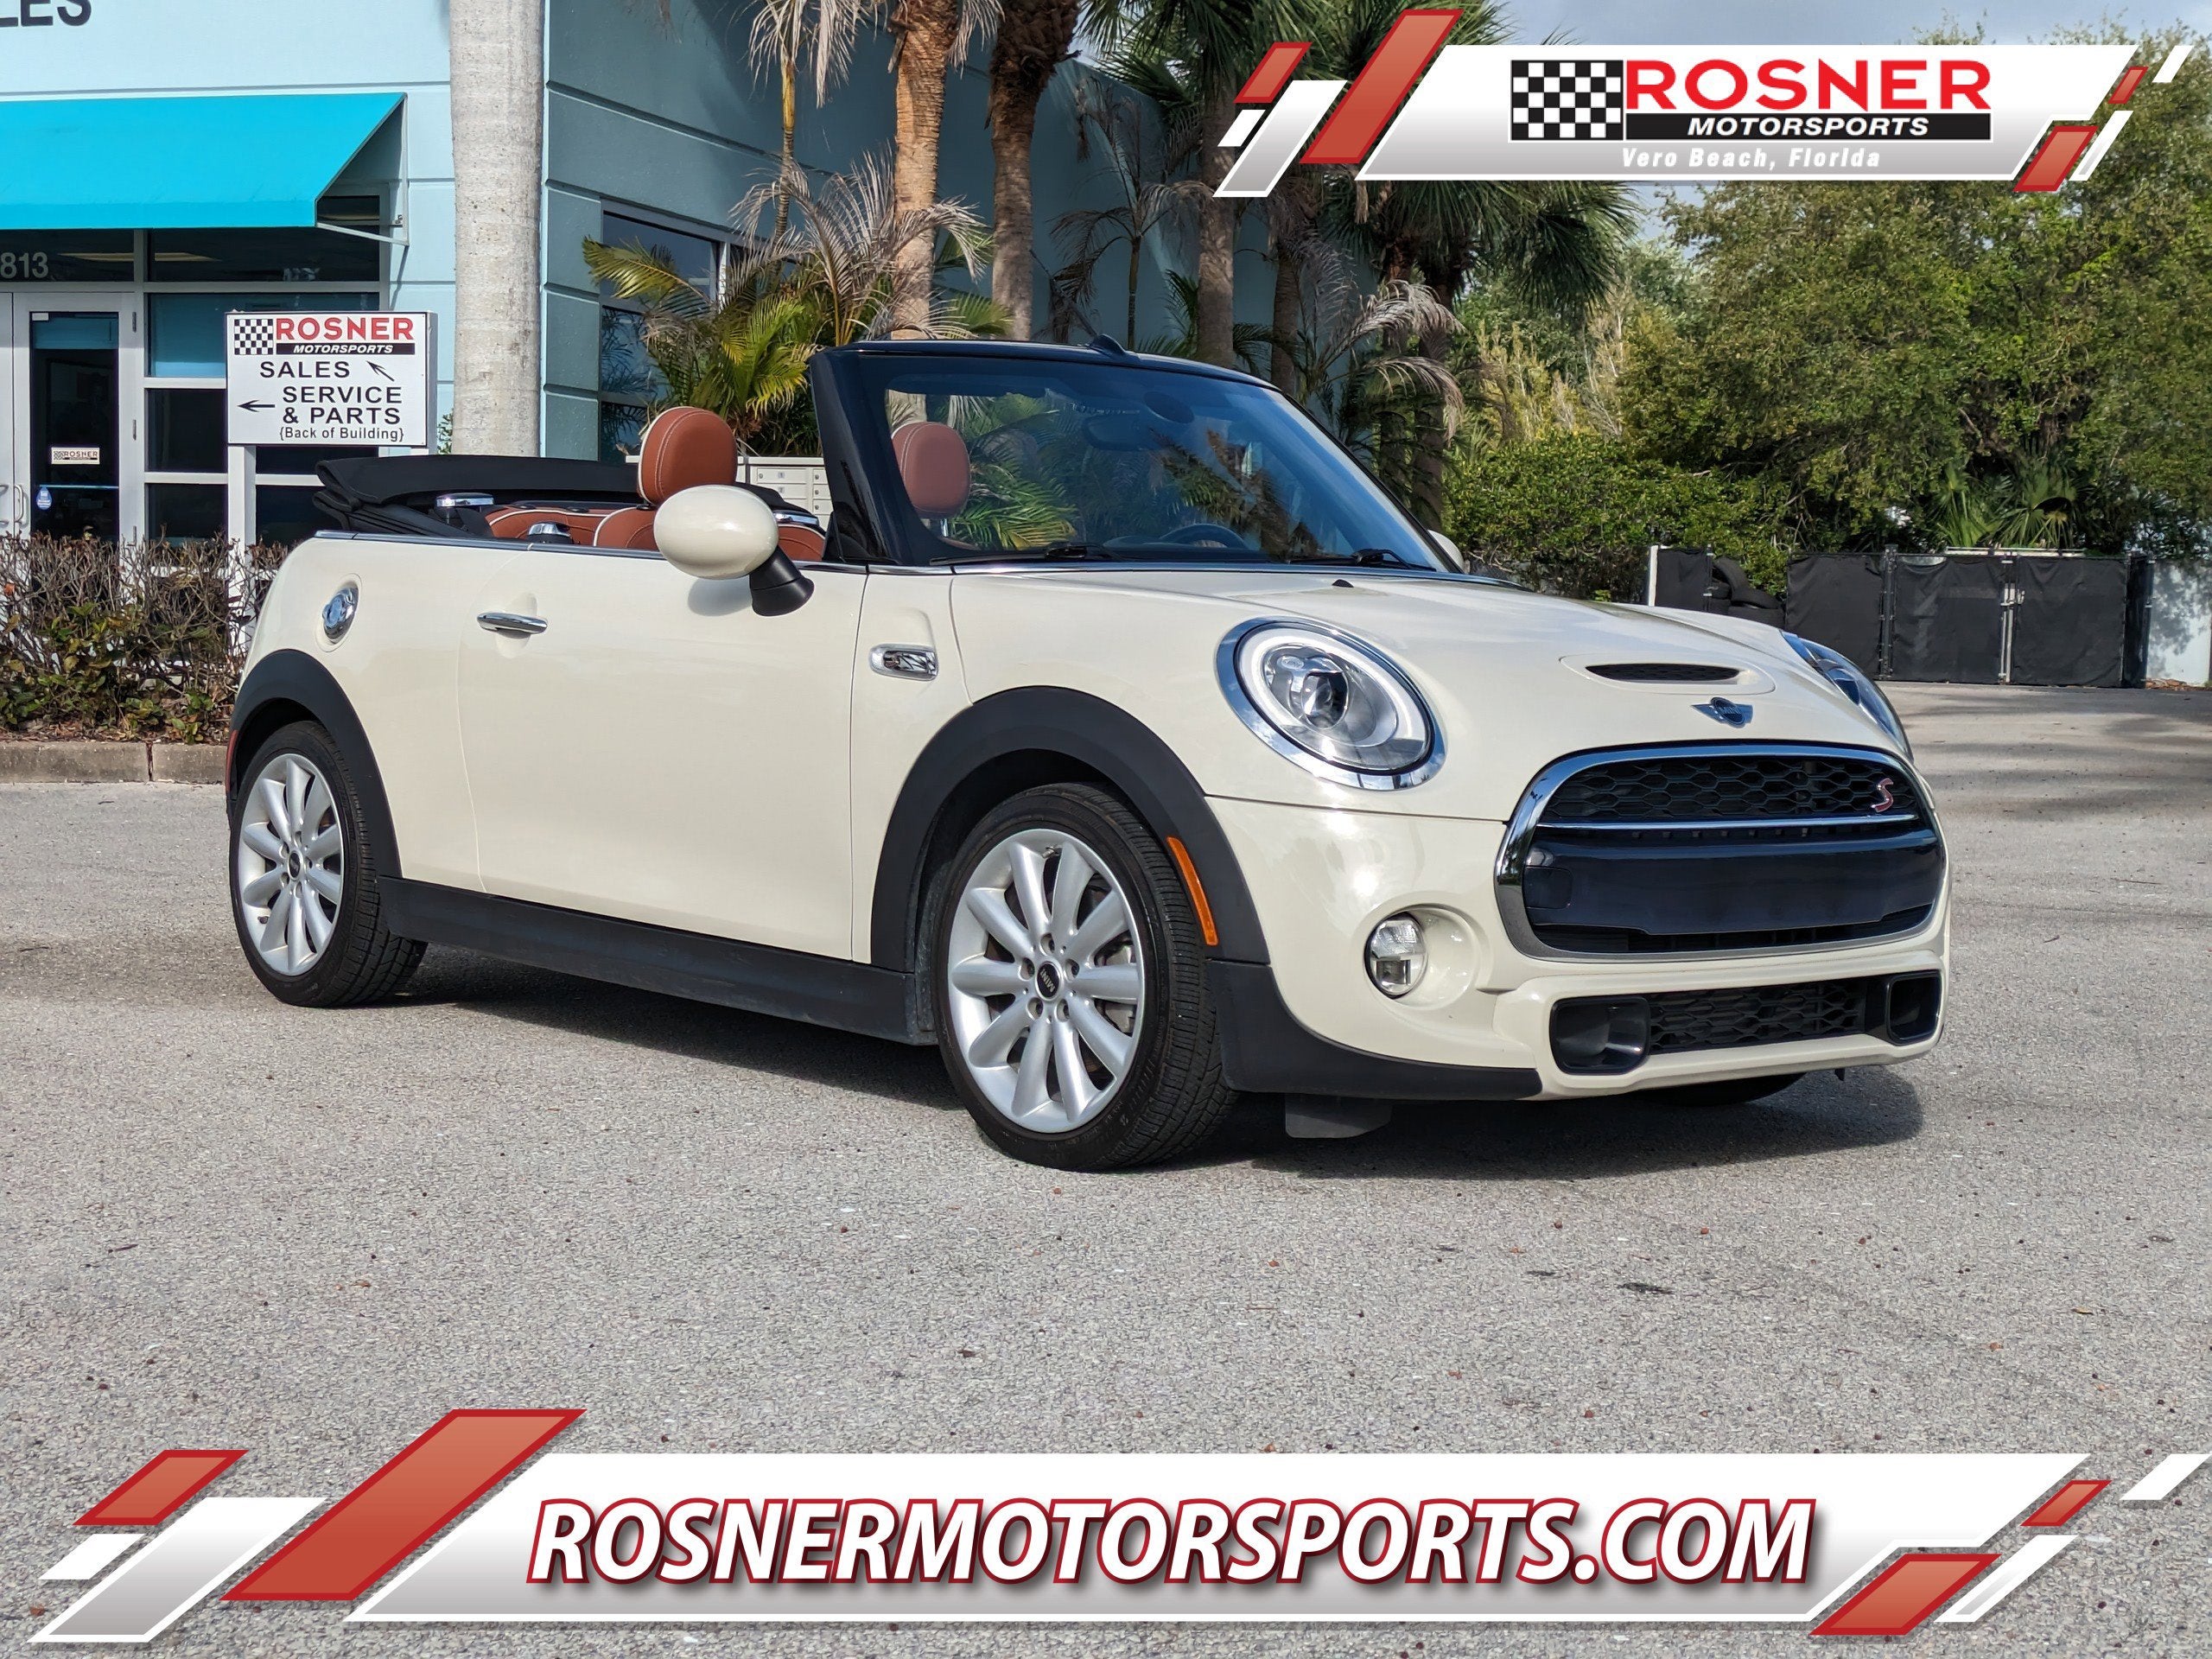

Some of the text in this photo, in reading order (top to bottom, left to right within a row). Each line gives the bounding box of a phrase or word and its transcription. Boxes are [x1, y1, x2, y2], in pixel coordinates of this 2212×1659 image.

[0, 251, 49, 278] 813
[276, 317, 414, 340] ROSNER
[293, 345, 394, 353] MOTORSPORTS
[259, 361, 351, 378] SALES
[282, 386, 403, 404] SERVICE
[283, 407, 401, 425] & PARTS
[321, 428, 335, 439] of
[1871, 778, 1894, 813] S
[1039, 968, 1056, 993] MINI
